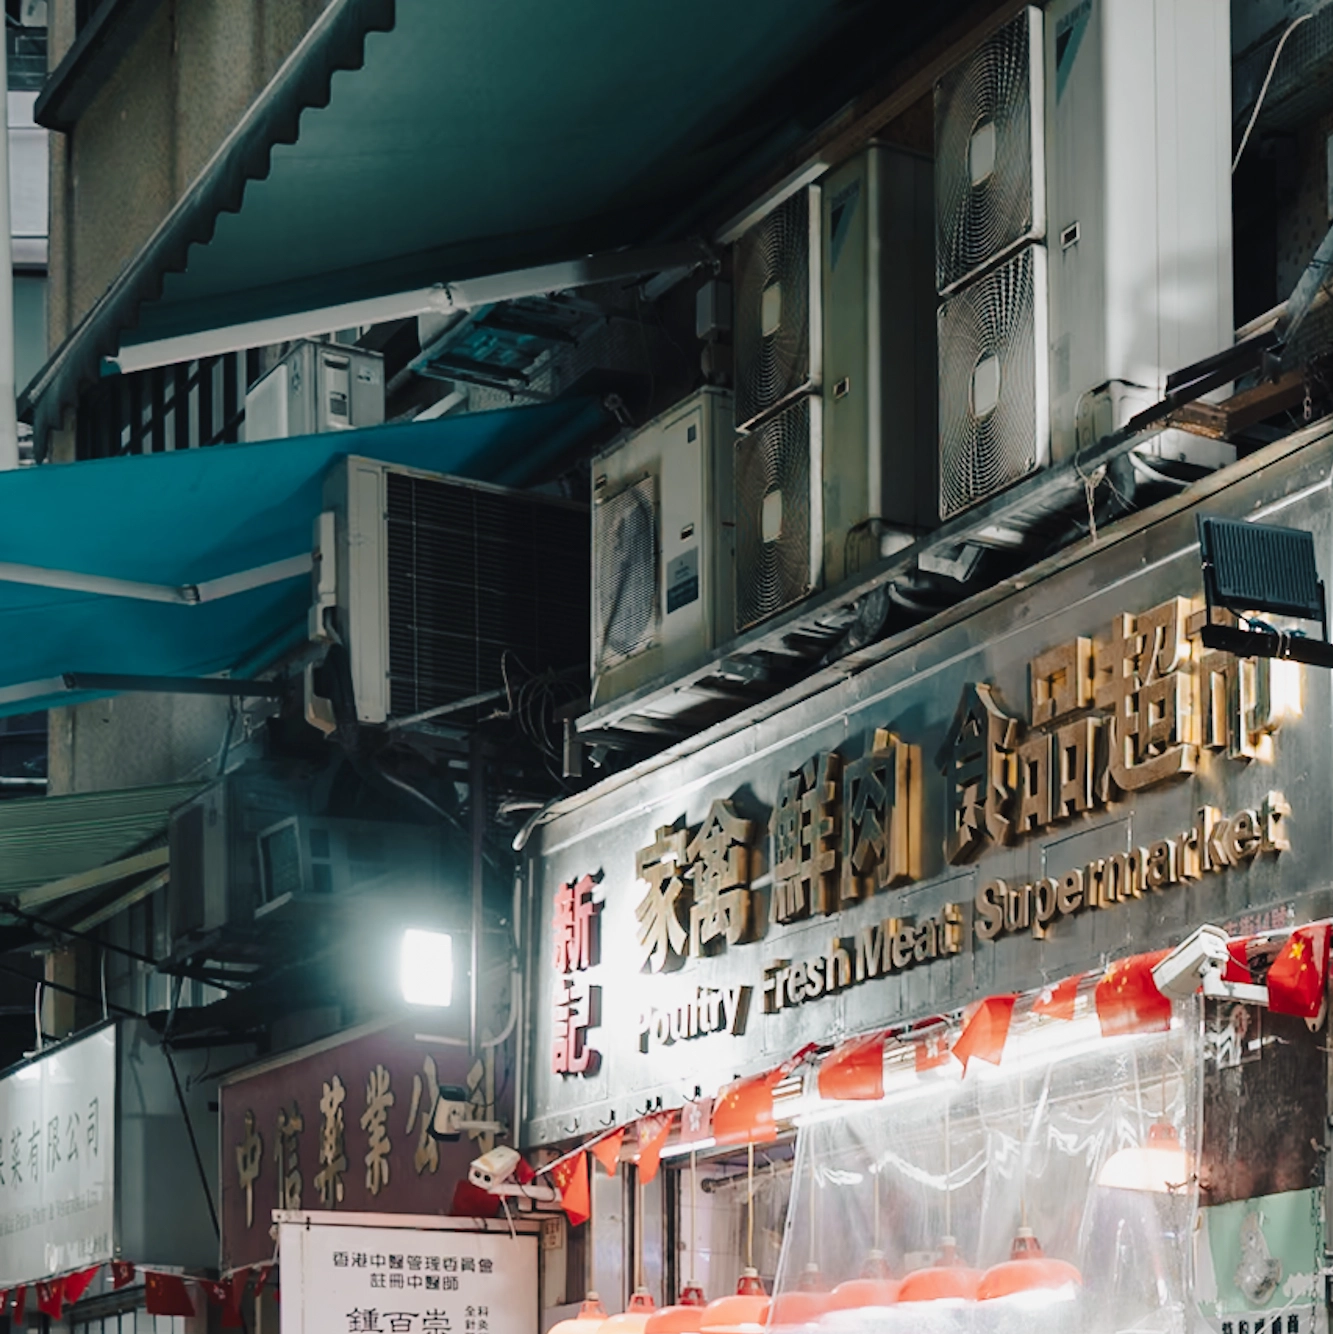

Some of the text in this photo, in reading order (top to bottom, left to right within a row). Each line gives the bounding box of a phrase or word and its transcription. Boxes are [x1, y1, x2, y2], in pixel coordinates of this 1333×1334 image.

[551, 869, 604, 1079] 新記
[639, 790, 1292, 1054] Poultry Fresh Meat Supermarket
[333, 1252, 494, 1274] 香港中醫管理委員會
[370, 1273, 460, 1292] 註冊中醫師
